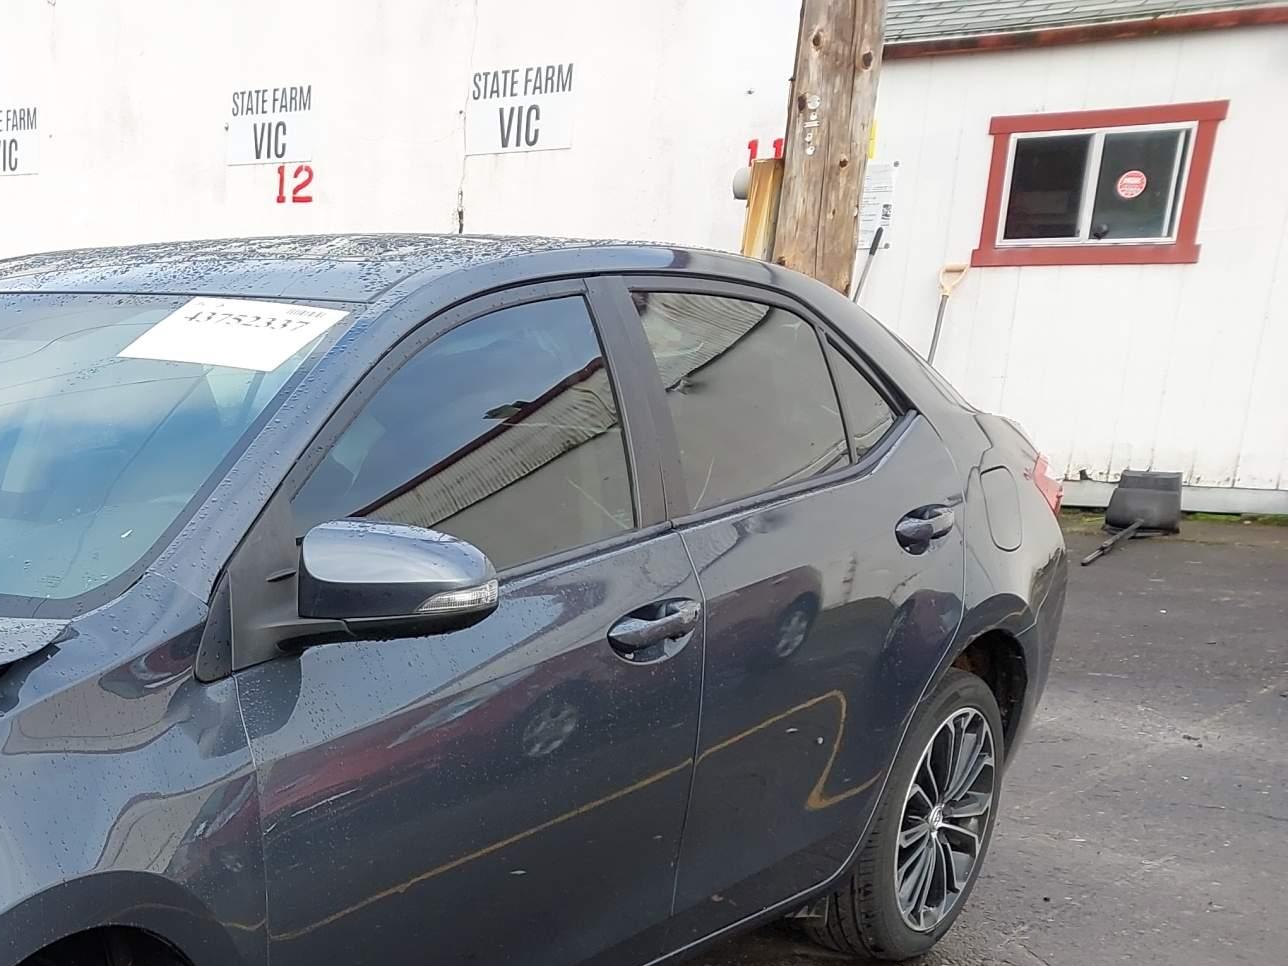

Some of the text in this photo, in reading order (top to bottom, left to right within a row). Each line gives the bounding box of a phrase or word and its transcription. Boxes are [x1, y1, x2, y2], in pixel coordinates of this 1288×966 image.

[232, 85, 312, 117] STATE FARM
[472, 63, 575, 101] STATE FARM
[5, 107, 38, 132] FARM
[499, 104, 541, 149] VIC
[253, 121, 287, 160] VIC
[277, 164, 314, 204] 12
[184, 311, 311, 332] 43752337
